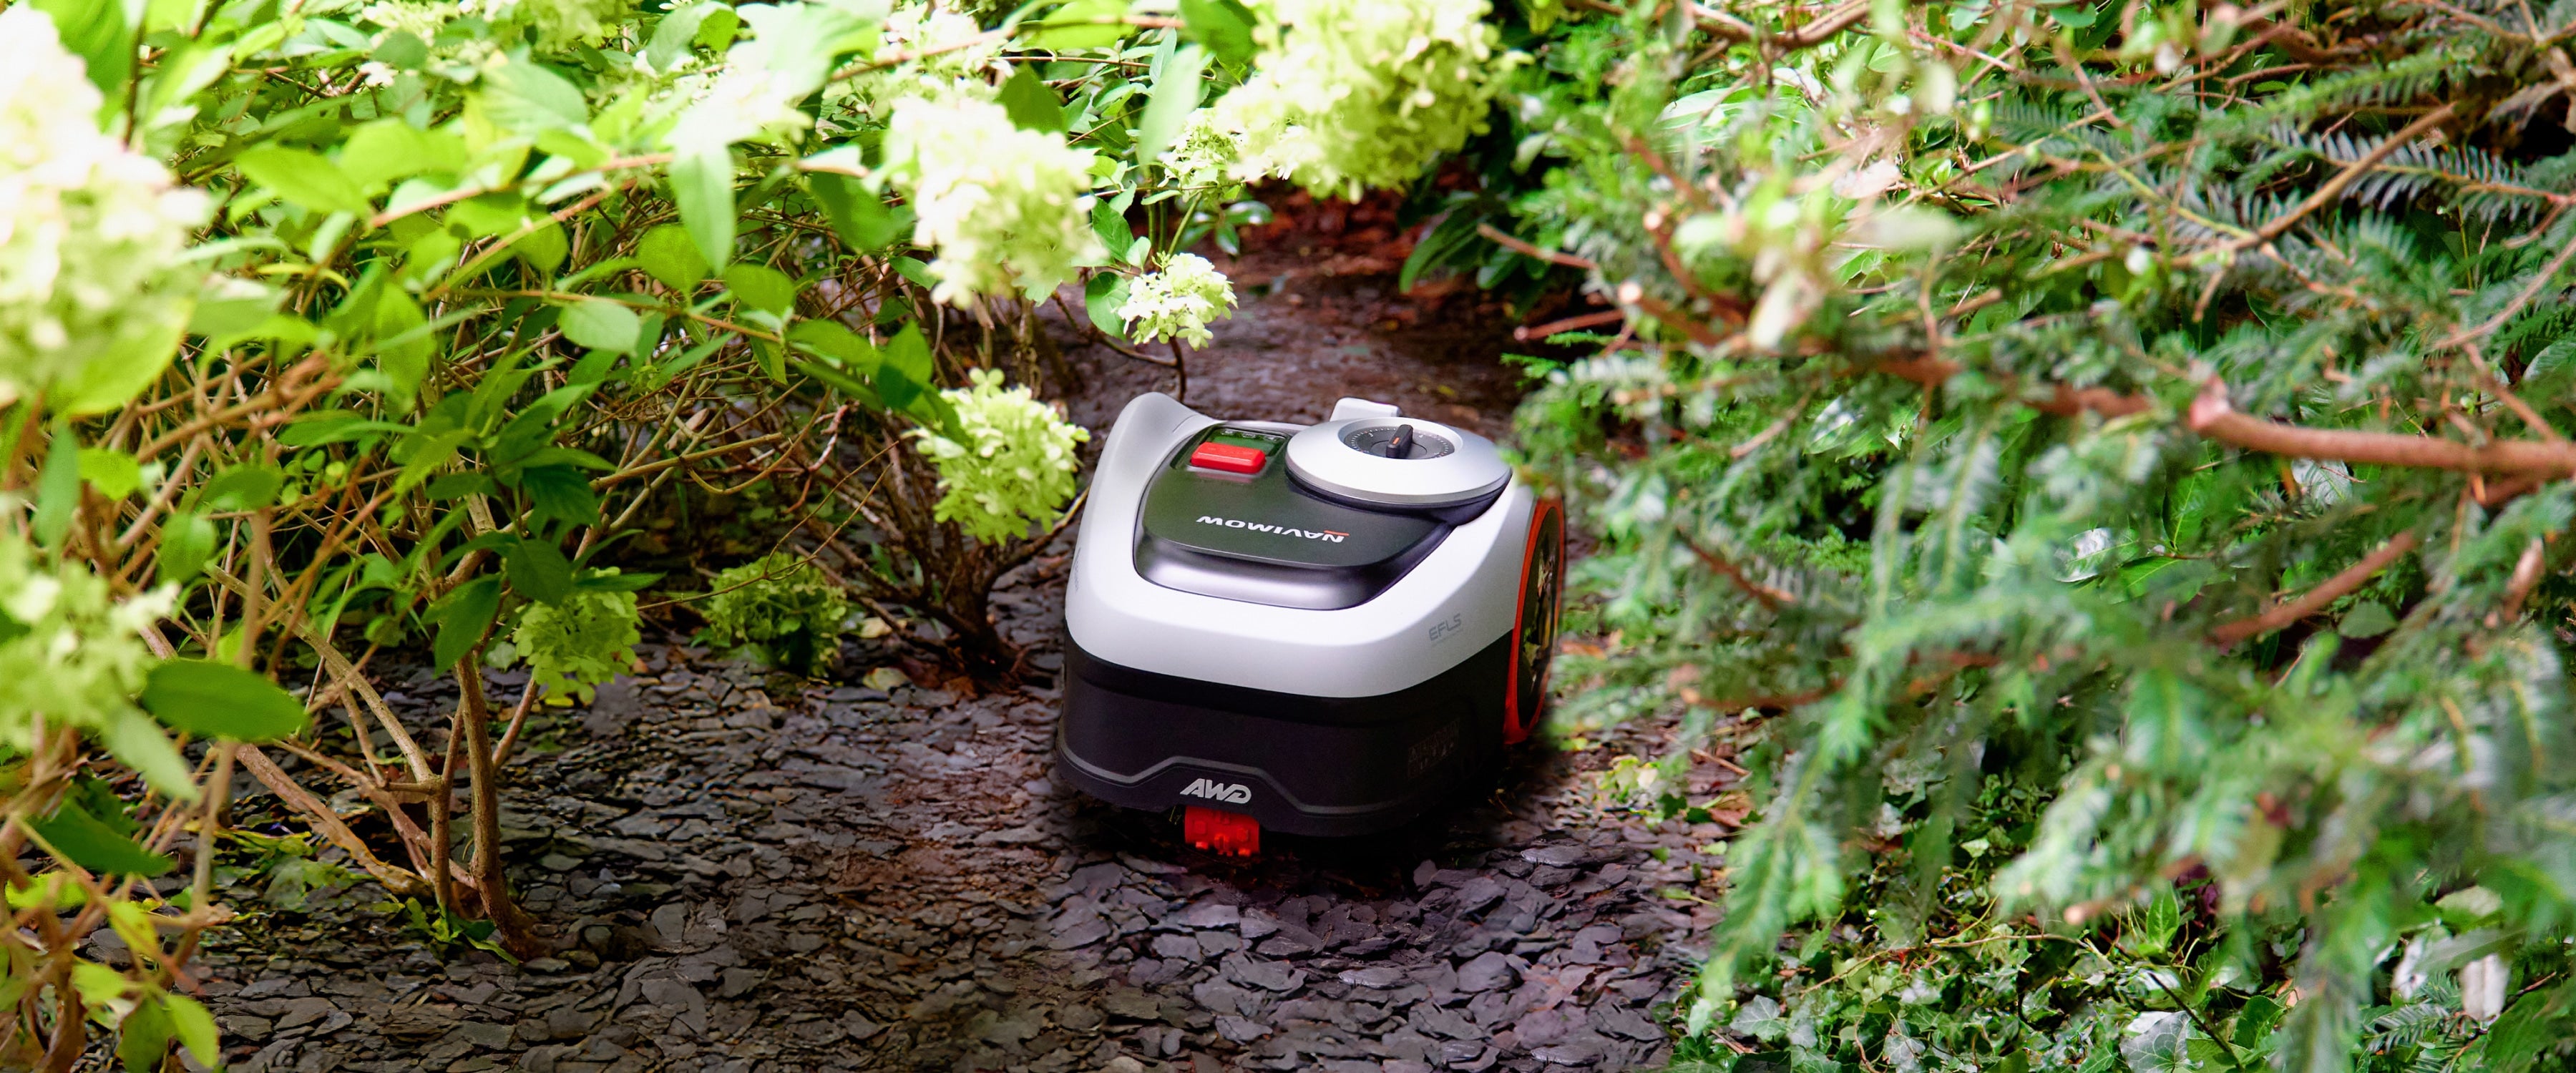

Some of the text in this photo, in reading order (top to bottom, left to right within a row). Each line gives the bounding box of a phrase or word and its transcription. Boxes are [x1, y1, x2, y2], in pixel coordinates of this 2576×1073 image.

[1196, 516, 1350, 543] NAVIMOW
[1428, 613, 1462, 641] EFLS
[1179, 778, 1252, 804] AWD
